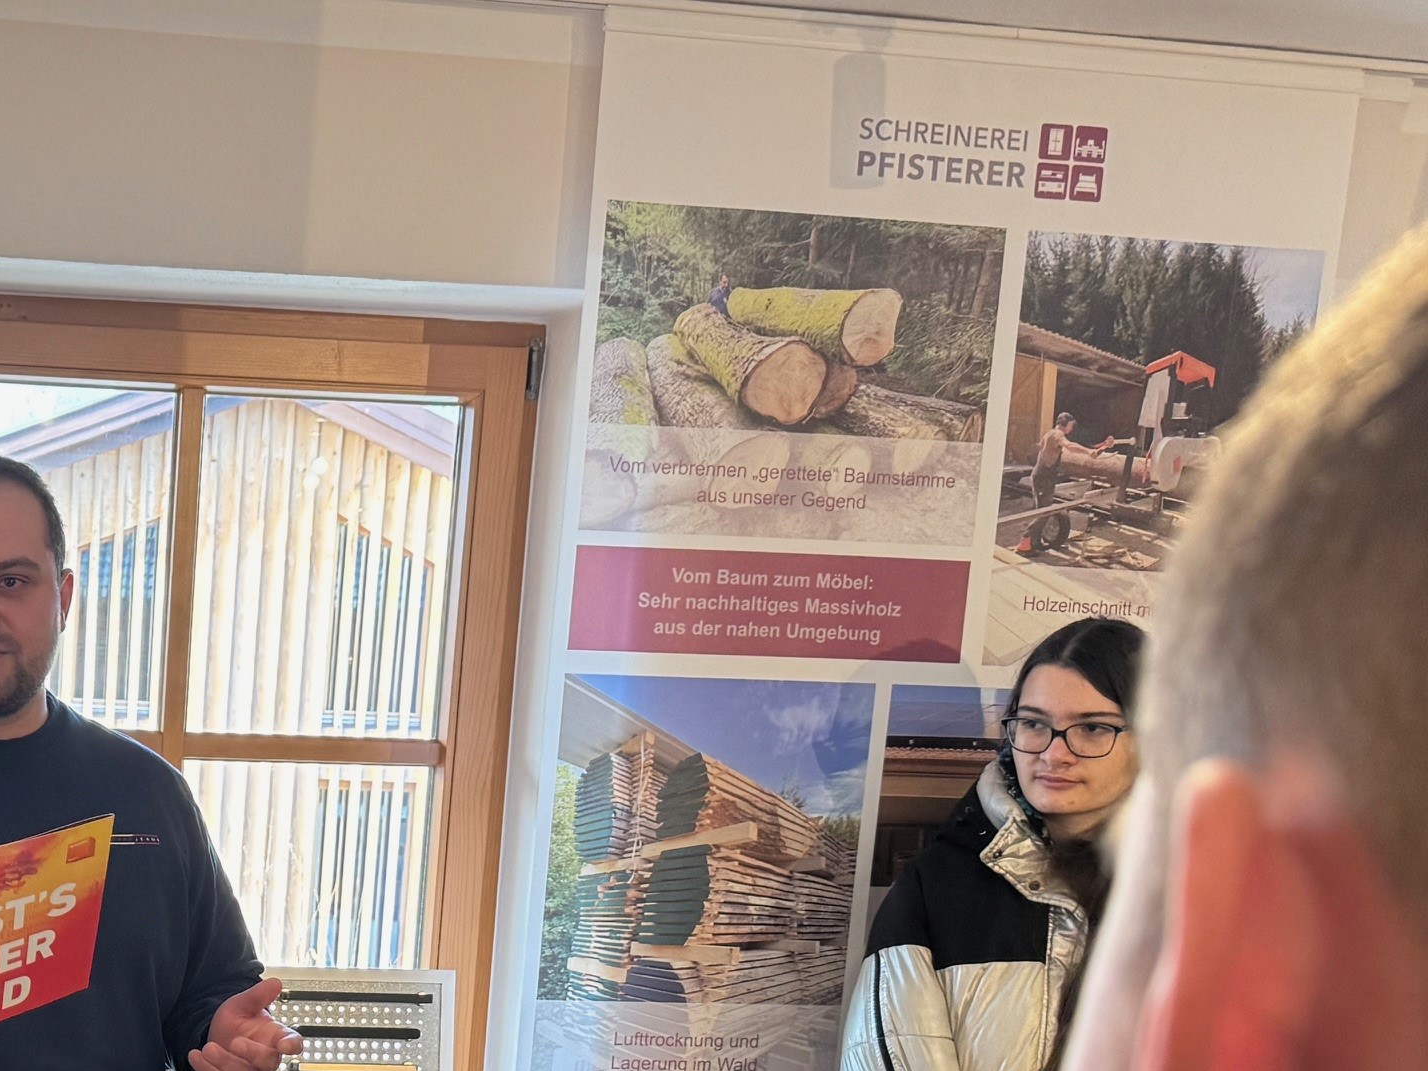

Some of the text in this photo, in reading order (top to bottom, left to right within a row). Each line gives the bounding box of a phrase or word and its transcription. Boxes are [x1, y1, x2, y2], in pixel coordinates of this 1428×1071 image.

[858, 117, 1029, 152] SCHREINEREI
[856, 150, 1026, 188] PFISTERER
[609, 455, 647, 475] Vom
[652, 459, 747, 480] verbrennen
[844, 467, 956, 490] Baumstämme
[696, 489, 867, 512] aus unserer Gegend
[672, 567, 873, 591] Vom Baum zum Möbel:
[637, 592, 902, 617] Sehr nachhaltiges Massivholz
[1023, 595, 1132, 617] Holzeinschnitt
[653, 620, 881, 646] aus der nahen Umgebung
[613, 1031, 759, 1051] Lufttrocknung und
[693, 1057, 711, 1071] im
